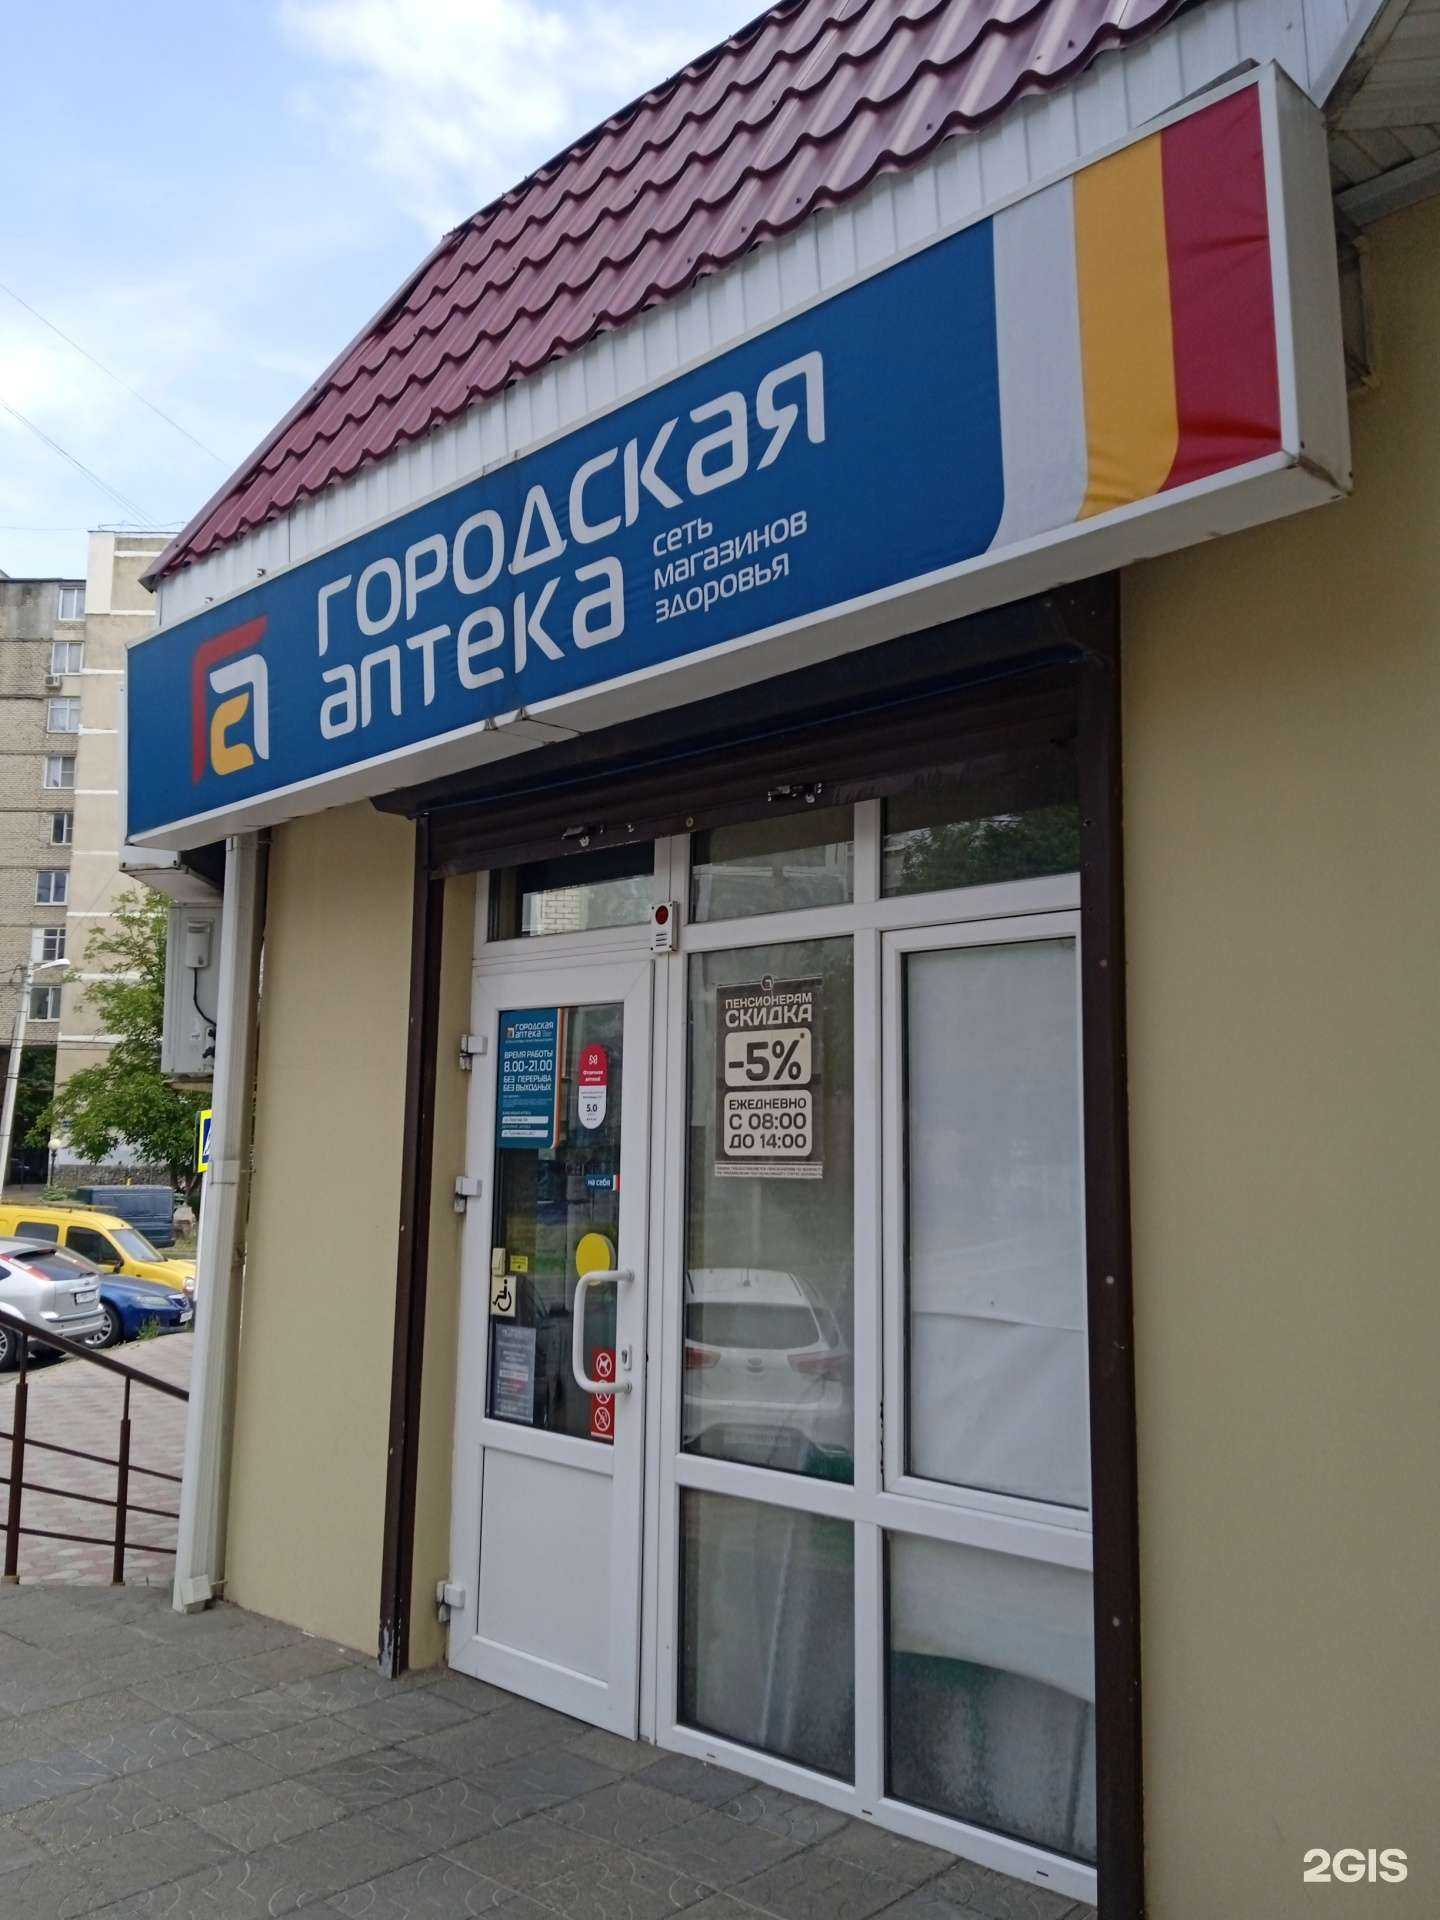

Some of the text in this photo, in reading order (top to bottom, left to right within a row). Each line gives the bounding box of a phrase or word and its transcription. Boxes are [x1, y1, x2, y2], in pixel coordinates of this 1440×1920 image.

[652, 517, 714, 557] сеть
[653, 510, 808, 591] магазинов
[655, 552, 791, 624] здоровья
[725, 992, 813, 1009] ПЕНСИОНЕРАМ
[725, 1004, 813, 1028] СКИДКА
[504, 1049, 553, 1059] ВРЕМЯ РАБОТЫ
[504, 1059, 553, 1073] 8.00-21.00
[515, 1082, 552, 1092] ВЫХОДНЫХ
[517, 1074, 552, 1083] ПЕРЕРЫВА
[729, 1097, 807, 1111] ЕЖЕДНЕВНО
[729, 1112, 807, 1130] С 08:00
[729, 1132, 807, 1150] ДО 14:00
